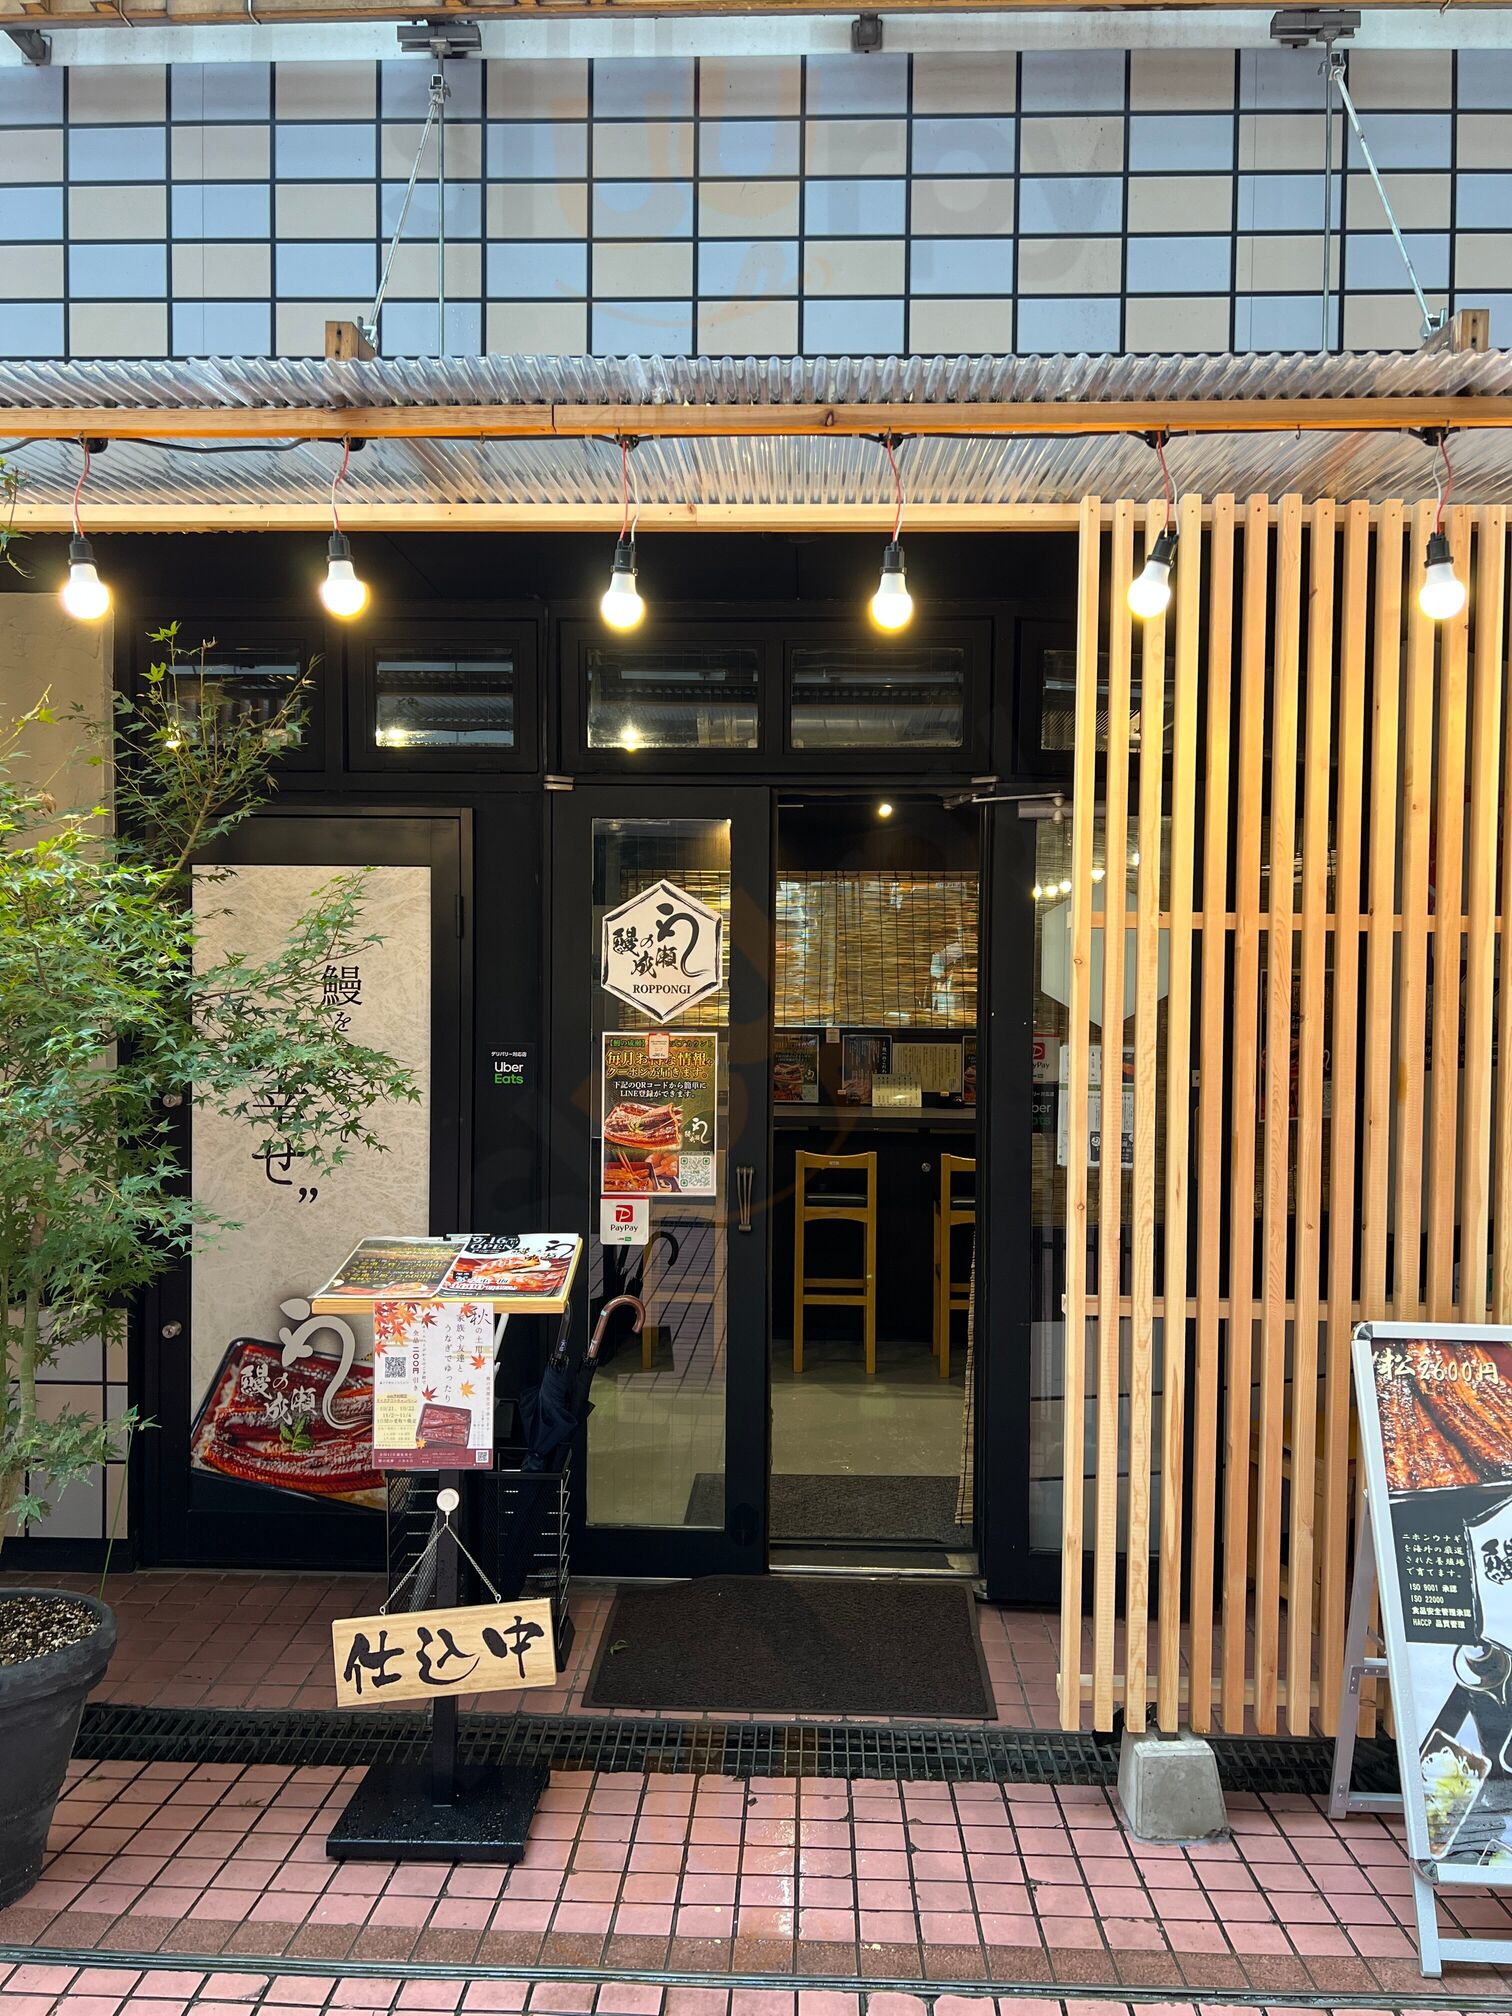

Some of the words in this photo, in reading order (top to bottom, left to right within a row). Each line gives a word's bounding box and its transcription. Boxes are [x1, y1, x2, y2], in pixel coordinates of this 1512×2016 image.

[632, 984, 691, 994] ROPPONGI
[494, 1061, 524, 1072] Uber
[494, 1073, 524, 1084] Eats
[610, 1224, 639, 1232] PayPay
[1402, 1533, 1461, 1543] ニホンウナギ
[1406, 1567, 1462, 1578] で育てます。
[1409, 1583, 1421, 1591] ISO
[1423, 1583, 1439, 1592] 9001
[1411, 1595, 1422, 1603] ISO
[1424, 1595, 1444, 1604] 22000
[1412, 1618, 1432, 1627] HACCP
[343, 1616, 545, 1695] 仕込中
